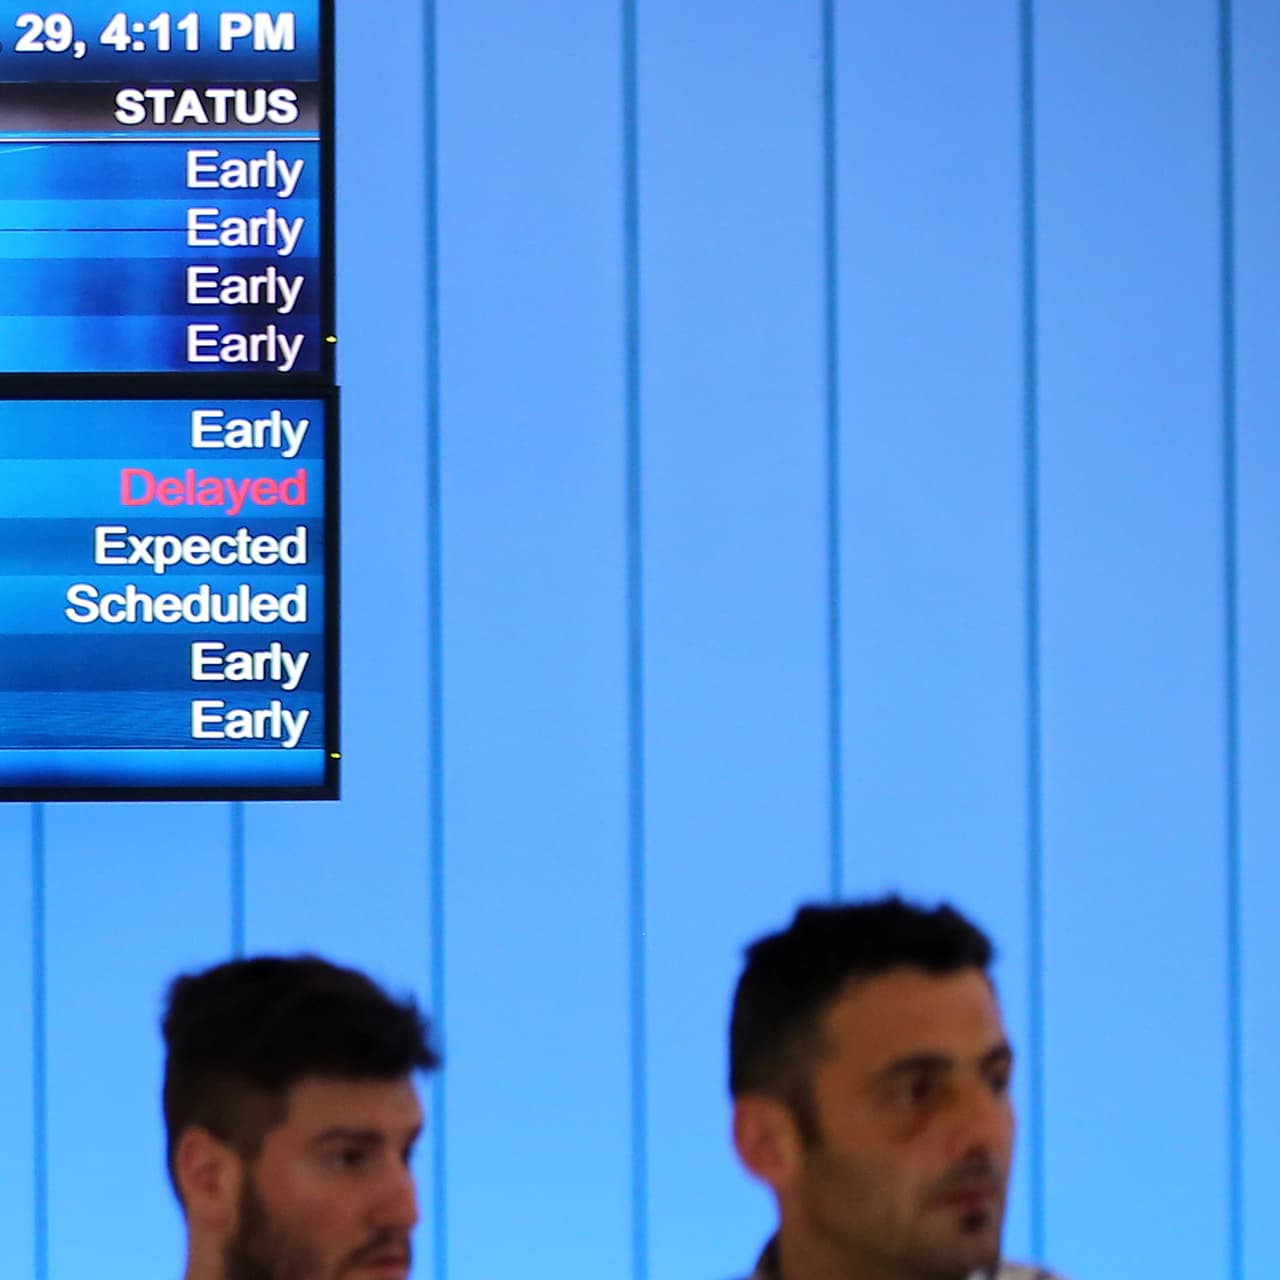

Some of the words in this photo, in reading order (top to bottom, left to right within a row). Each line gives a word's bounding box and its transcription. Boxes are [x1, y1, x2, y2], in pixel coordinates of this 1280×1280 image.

[15, 12, 86, 59] 29,
[100, 12, 198, 51] 4:11
[219, 12, 295, 51] PM
[114, 88, 298, 124] STATUS
[187, 149, 305, 198] Early
[187, 207, 305, 256] Early
[187, 266, 304, 314] Early
[187, 324, 305, 372] Early
[191, 409, 309, 458] Early
[120, 467, 307, 516] Delayed
[95, 526, 307, 574] Expected
[65, 583, 307, 623] Scheduled
[191, 642, 310, 690] Early
[191, 700, 310, 748] Early
